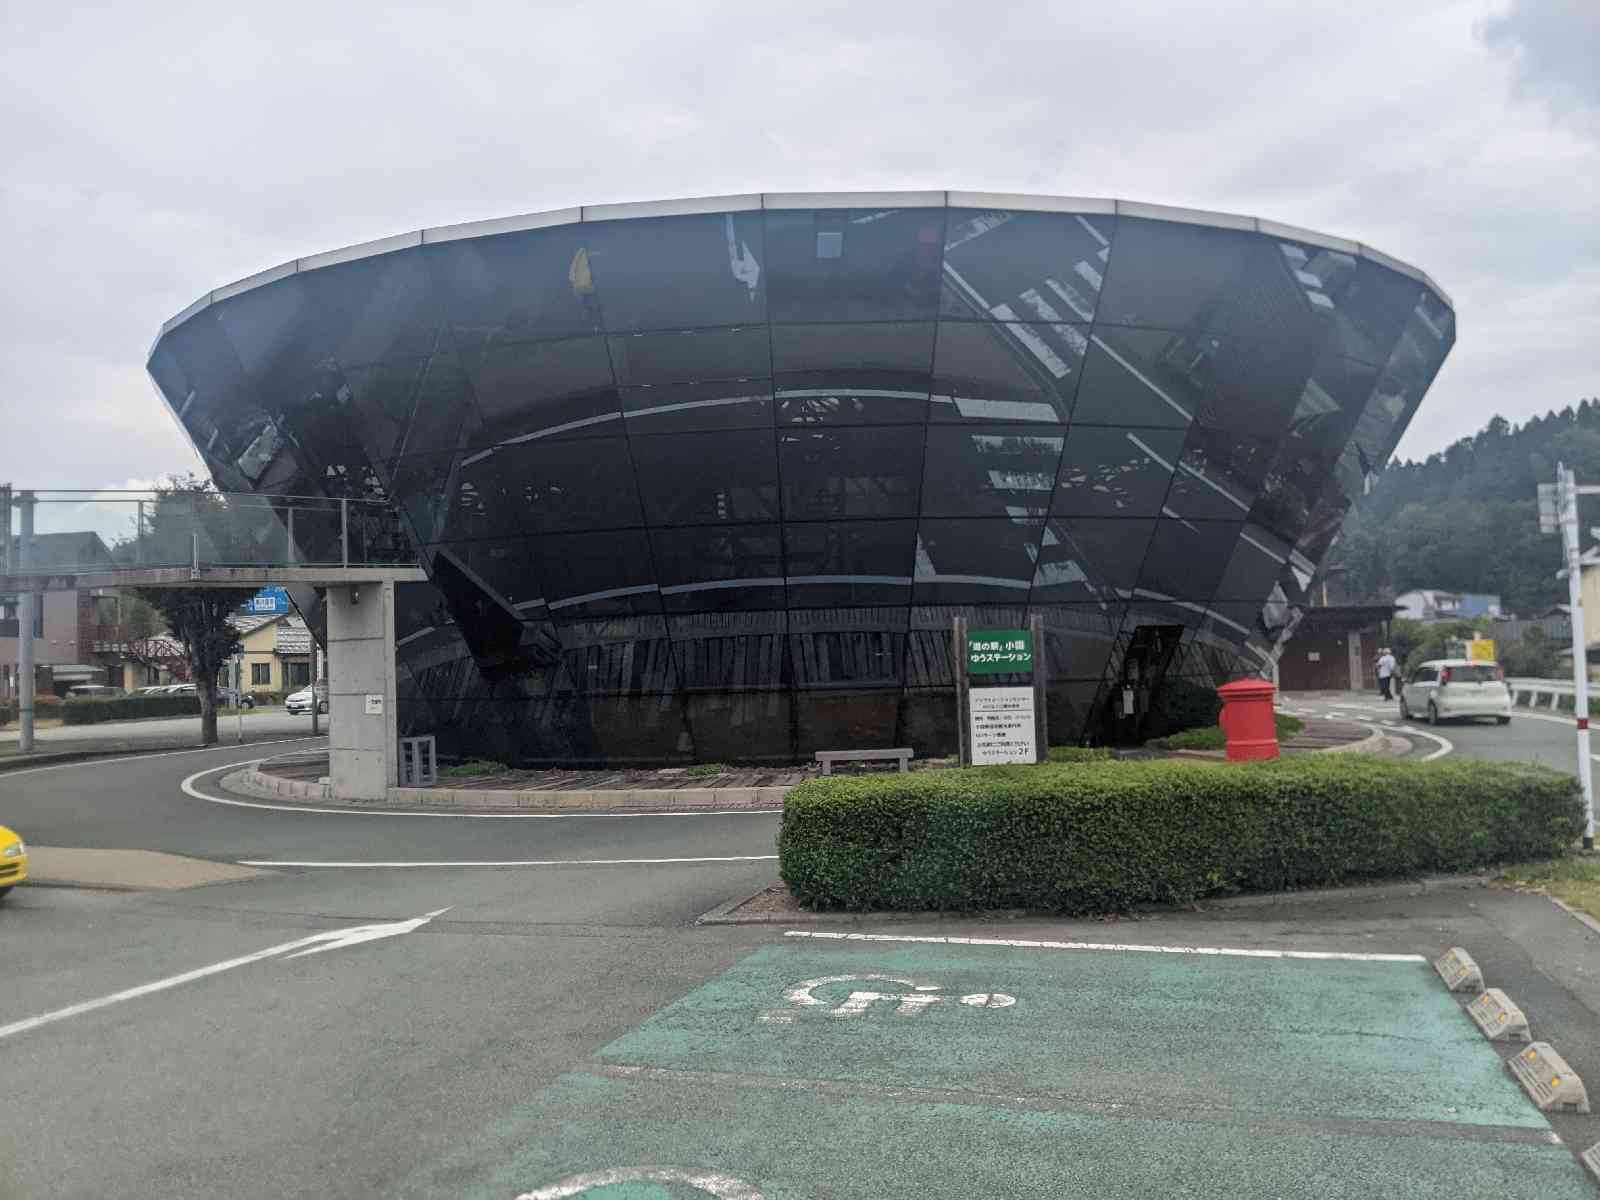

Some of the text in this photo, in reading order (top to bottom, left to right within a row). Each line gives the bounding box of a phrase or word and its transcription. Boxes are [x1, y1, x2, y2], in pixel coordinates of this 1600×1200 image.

[971, 653, 1031, 662] ゆうステーション
